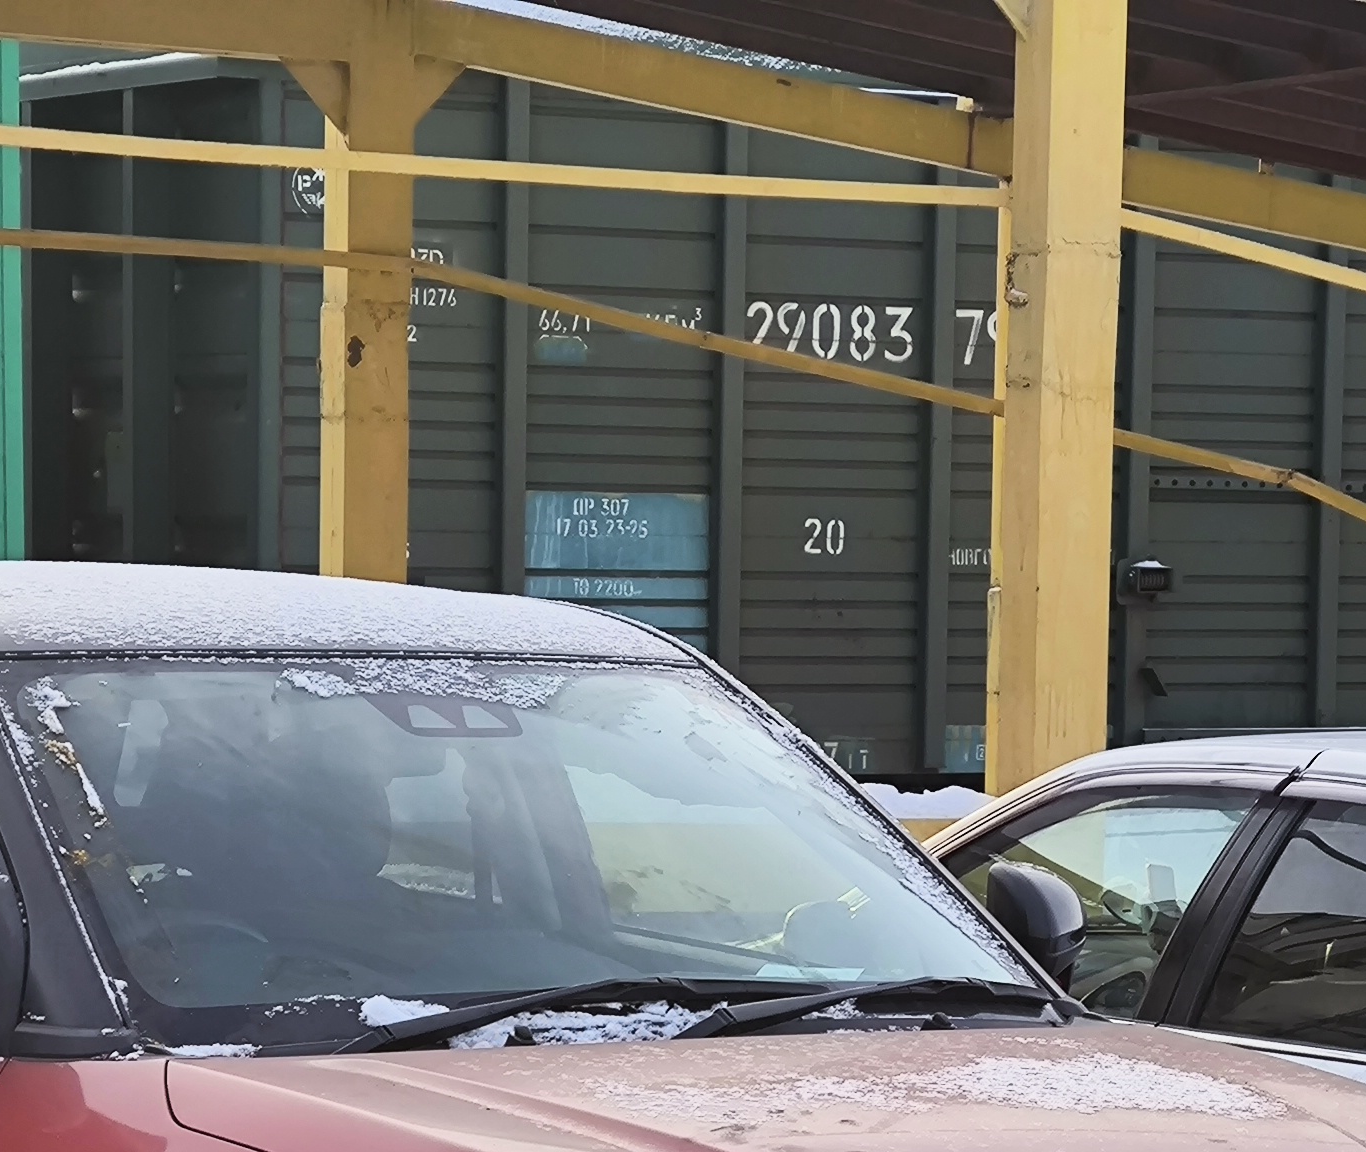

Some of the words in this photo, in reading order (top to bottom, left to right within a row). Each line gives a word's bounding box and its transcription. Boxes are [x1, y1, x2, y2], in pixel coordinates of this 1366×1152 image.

[746, 301, 913, 363] 29083
[601, 498, 629, 516] 307
[804, 518, 845, 555] 20
